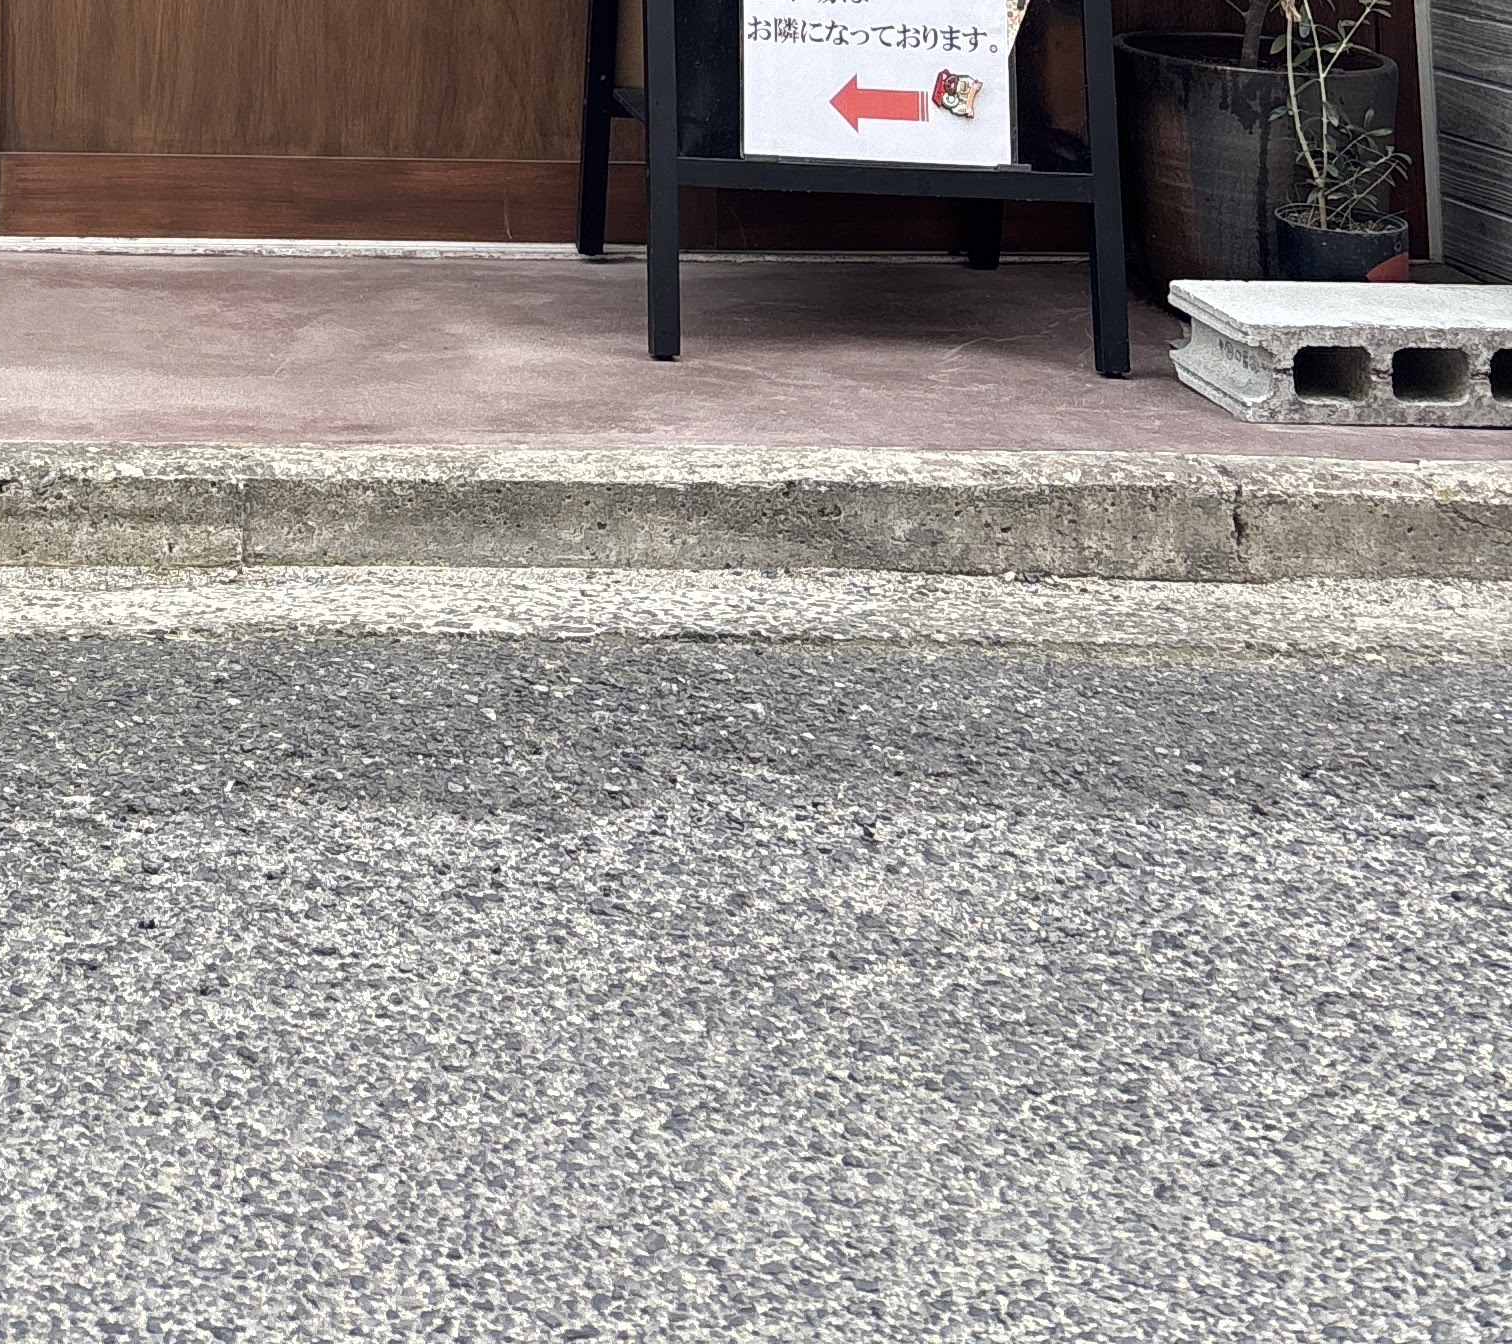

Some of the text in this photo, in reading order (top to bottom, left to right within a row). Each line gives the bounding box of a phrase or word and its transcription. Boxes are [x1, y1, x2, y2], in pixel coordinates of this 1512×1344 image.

[747, 16, 998, 54] お隣になっております。
